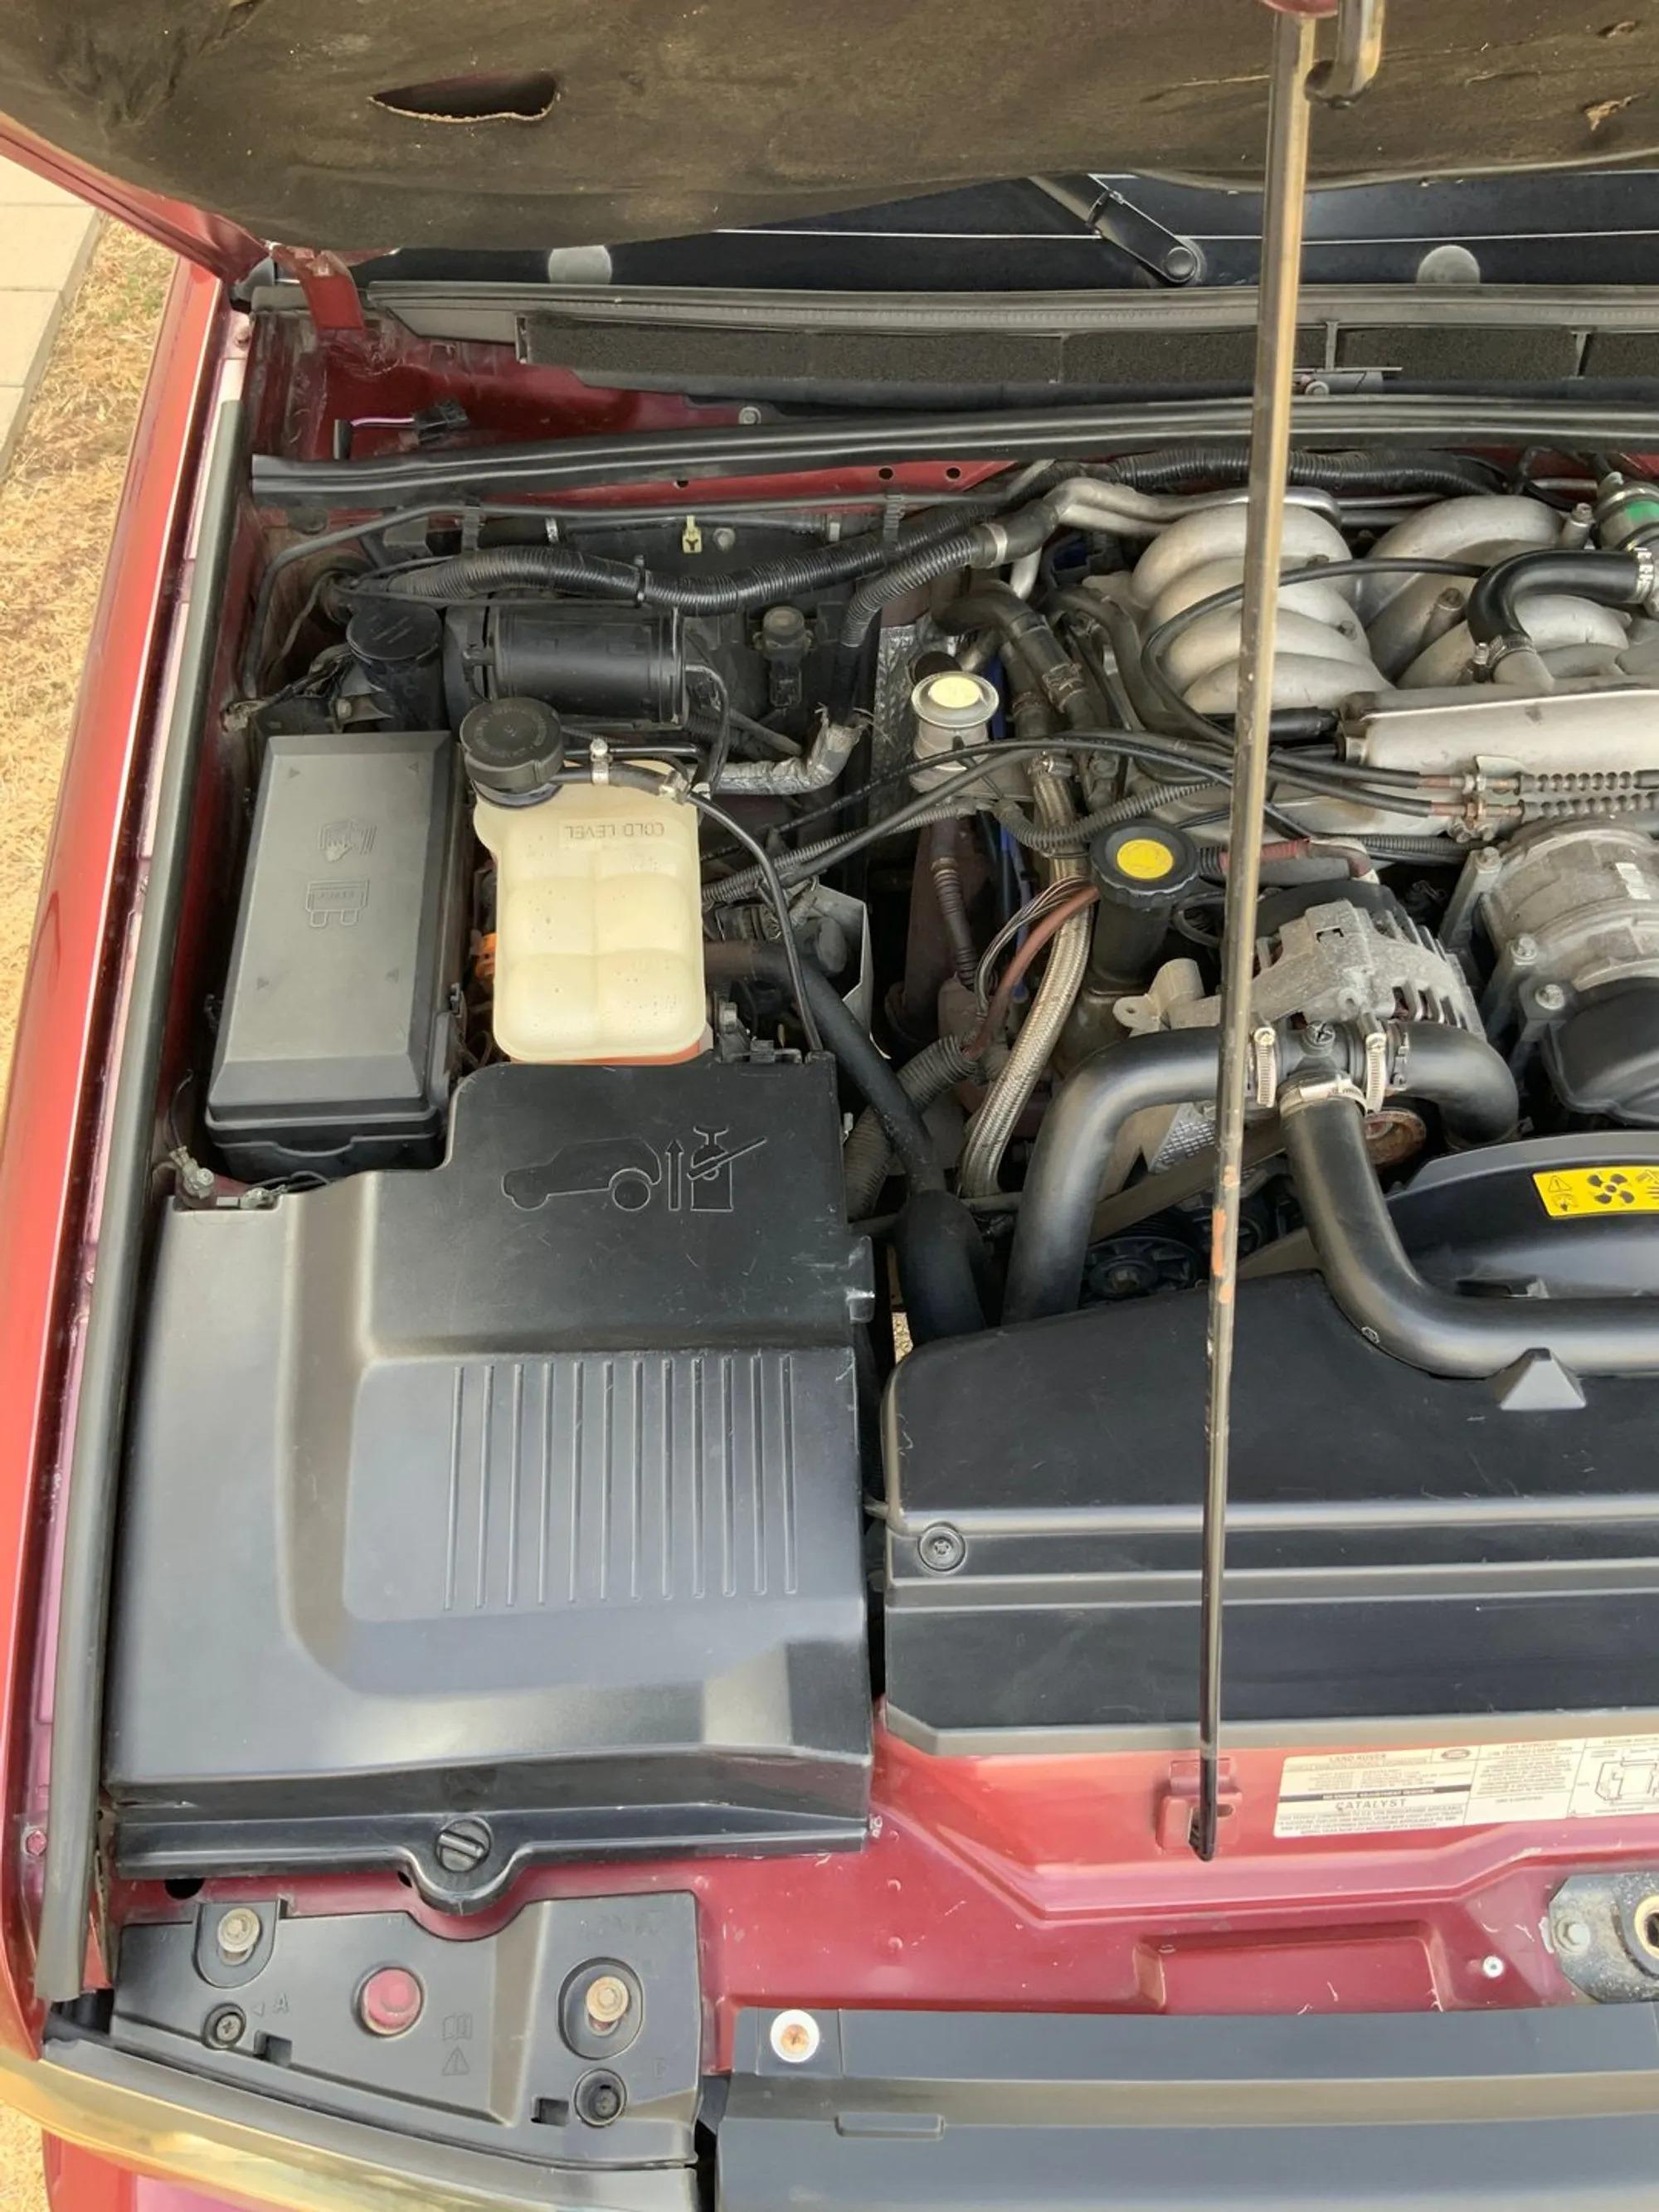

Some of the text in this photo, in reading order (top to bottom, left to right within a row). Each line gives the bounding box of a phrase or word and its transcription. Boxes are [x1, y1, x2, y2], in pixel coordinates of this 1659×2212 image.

[565, 822, 665, 840] COLD LEVEL
[1335, 1798, 1406, 1811] CATALYST
